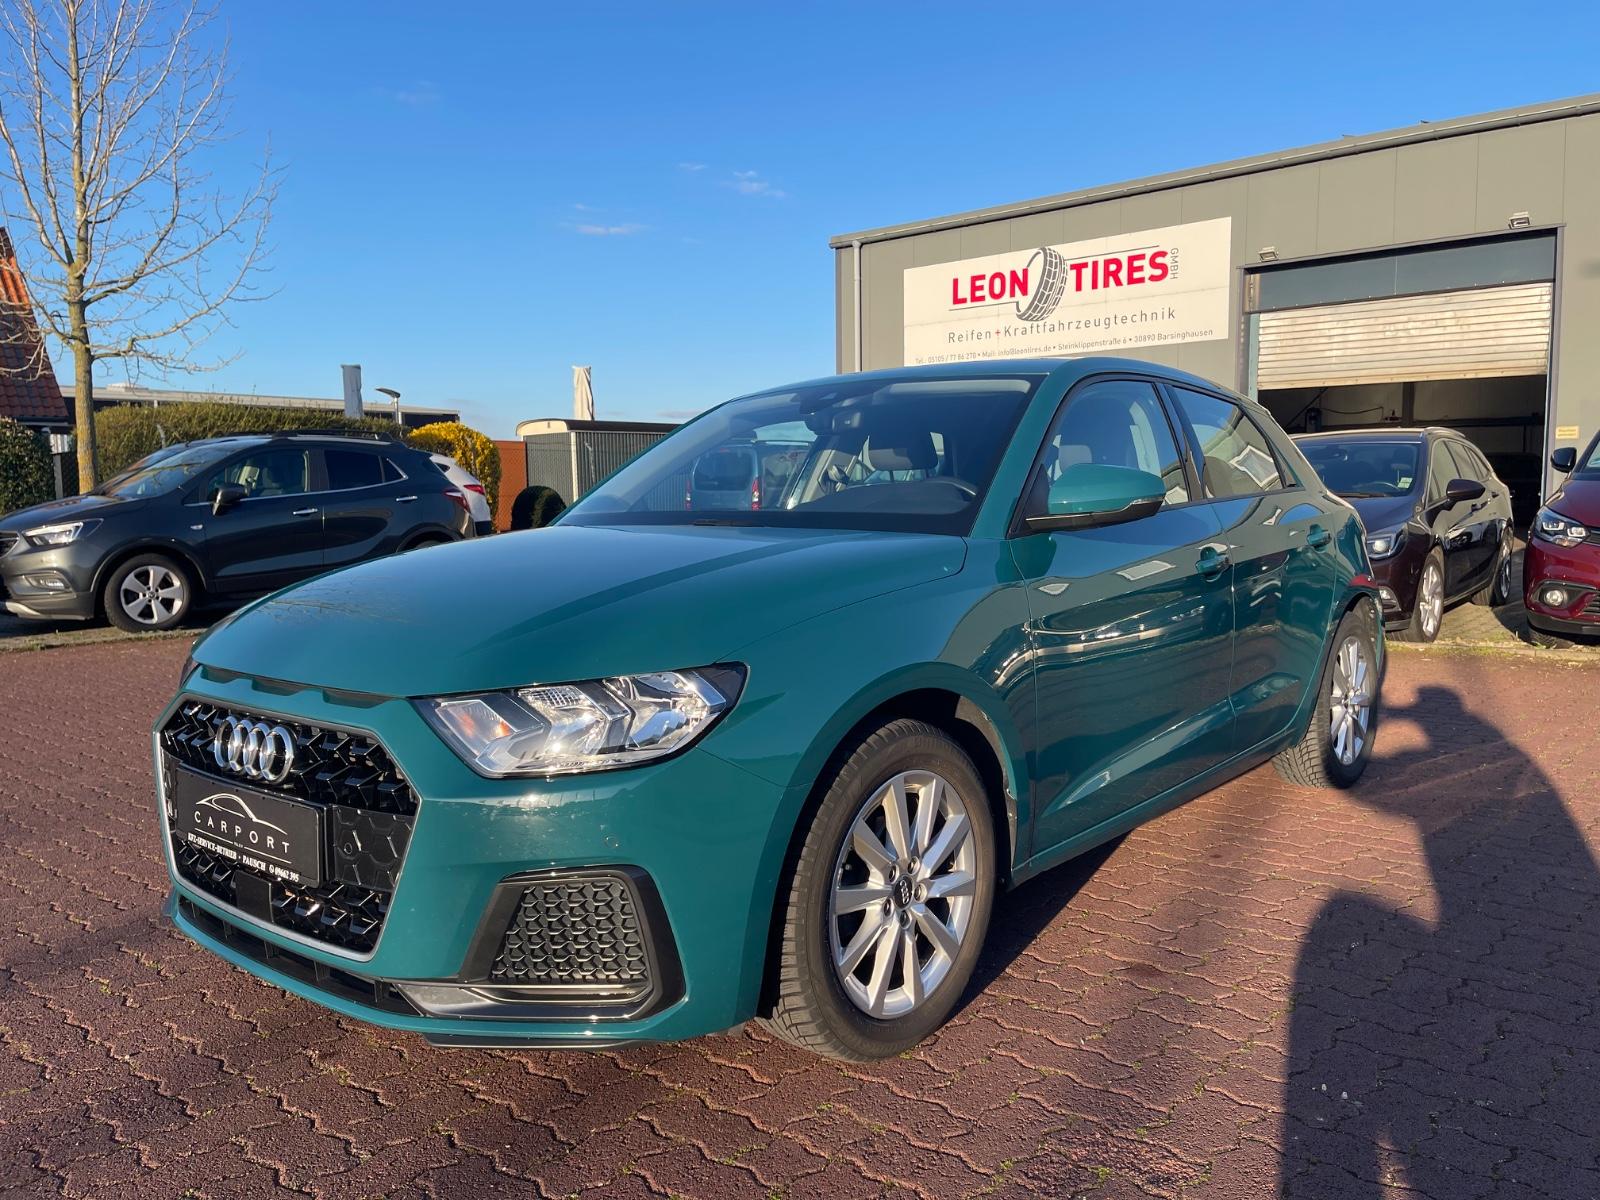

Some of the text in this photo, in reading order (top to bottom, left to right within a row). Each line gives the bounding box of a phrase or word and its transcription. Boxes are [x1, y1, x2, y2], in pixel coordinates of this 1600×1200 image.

[953, 250, 1169, 305] LEON TIRES
[1169, 247, 1179, 280] GMBH
[1157, 328, 1214, 342] Barsinghausen
[194, 811, 290, 854] CARPORT
[242, 855, 266, 871] PAUSCH
